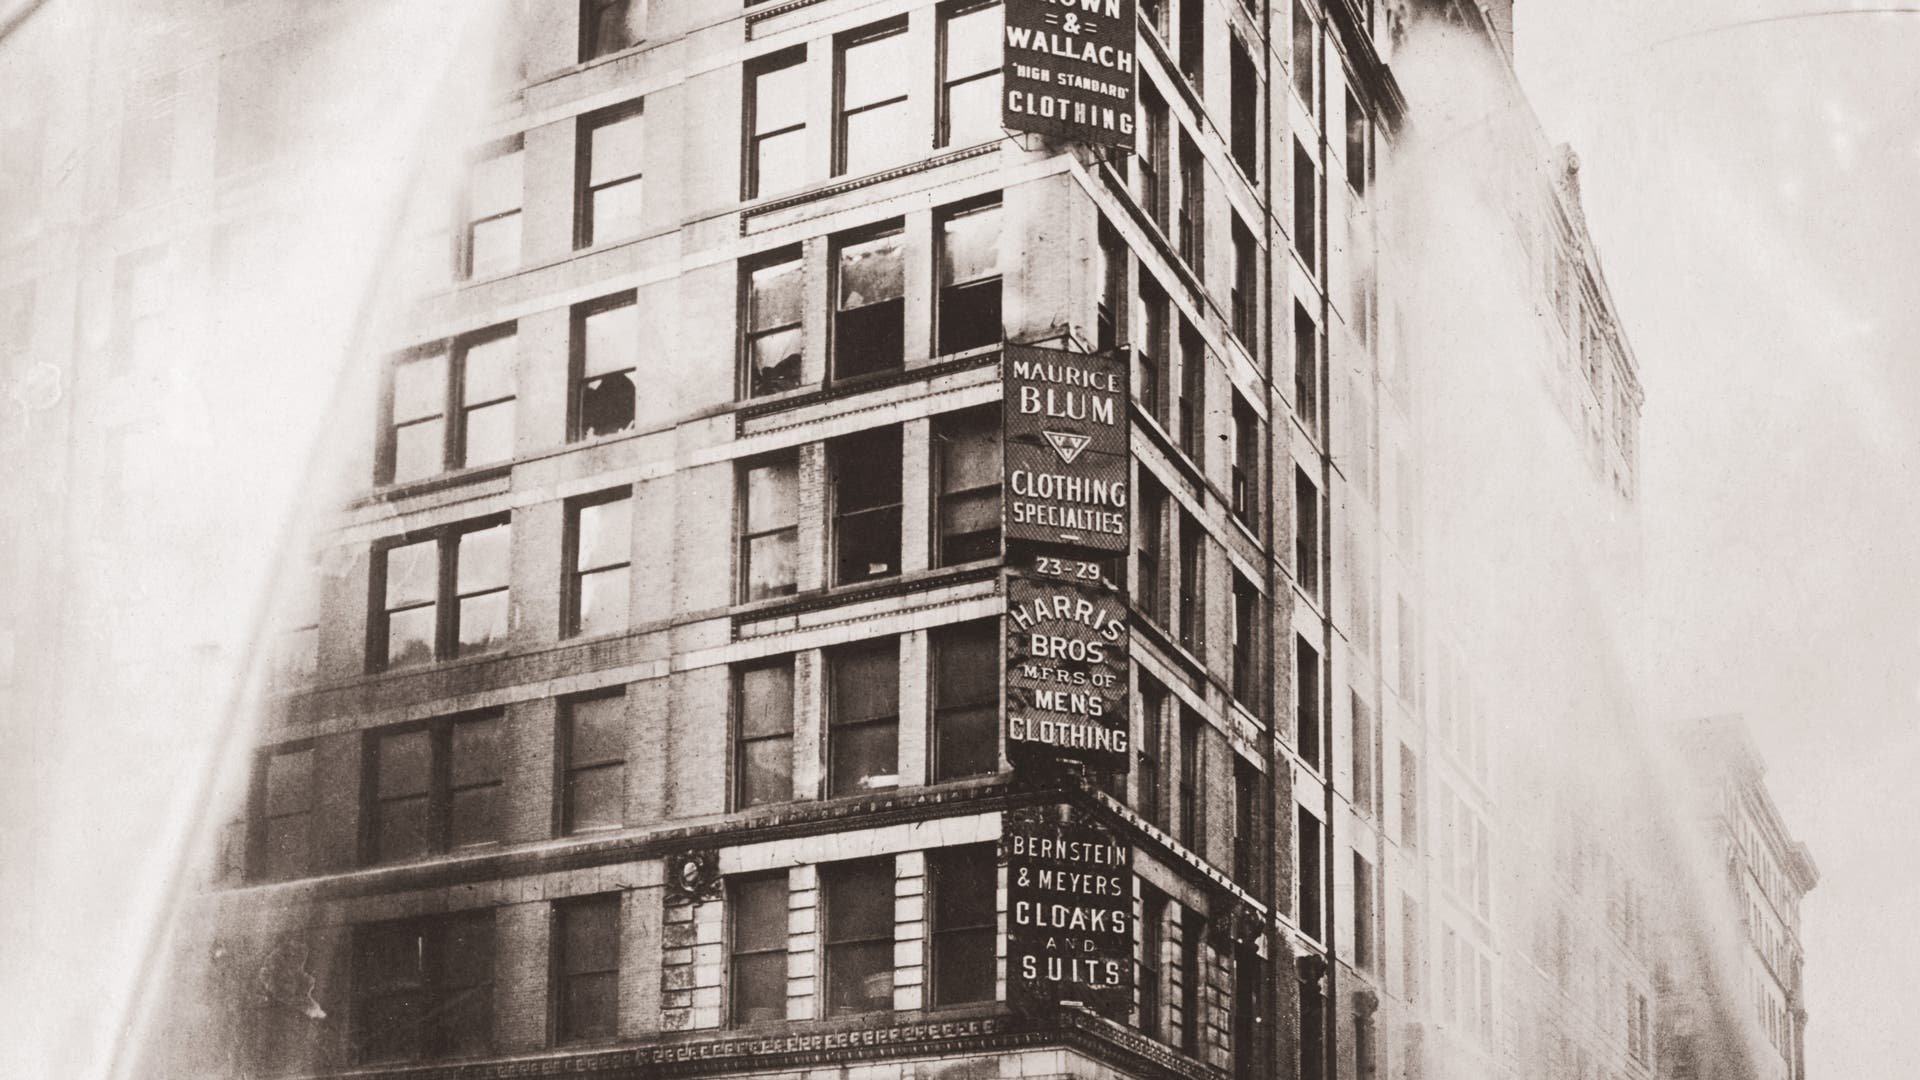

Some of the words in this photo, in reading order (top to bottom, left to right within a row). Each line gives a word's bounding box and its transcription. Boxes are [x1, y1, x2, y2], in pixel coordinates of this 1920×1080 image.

[1063, 12, 1081, 34] &
[1006, 25, 1132, 74] WALLACH
[1008, 90, 1133, 135] CLOTHING
[1013, 361, 1121, 393] MAURICE
[1020, 386, 1115, 425] BLUM
[1011, 470, 1126, 508] CLOTHING
[1013, 502, 1123, 534] SPECIALTIES
[1036, 556, 1100, 580] 23-29
[1010, 595, 1125, 641] HARRIS
[1092, 673, 1117, 687] OF
[1035, 689, 1103, 717] MEN'S
[1009, 717, 1127, 753] CLOTHING
[1014, 835, 1126, 865] BERNSTEIN
[1017, 867, 1031, 887] &
[1039, 869, 1122, 896] MEYERS
[1016, 901, 1125, 934] CLOAKS
[1046, 937, 1096, 953] AND
[1022, 955, 1119, 985] SUITS
